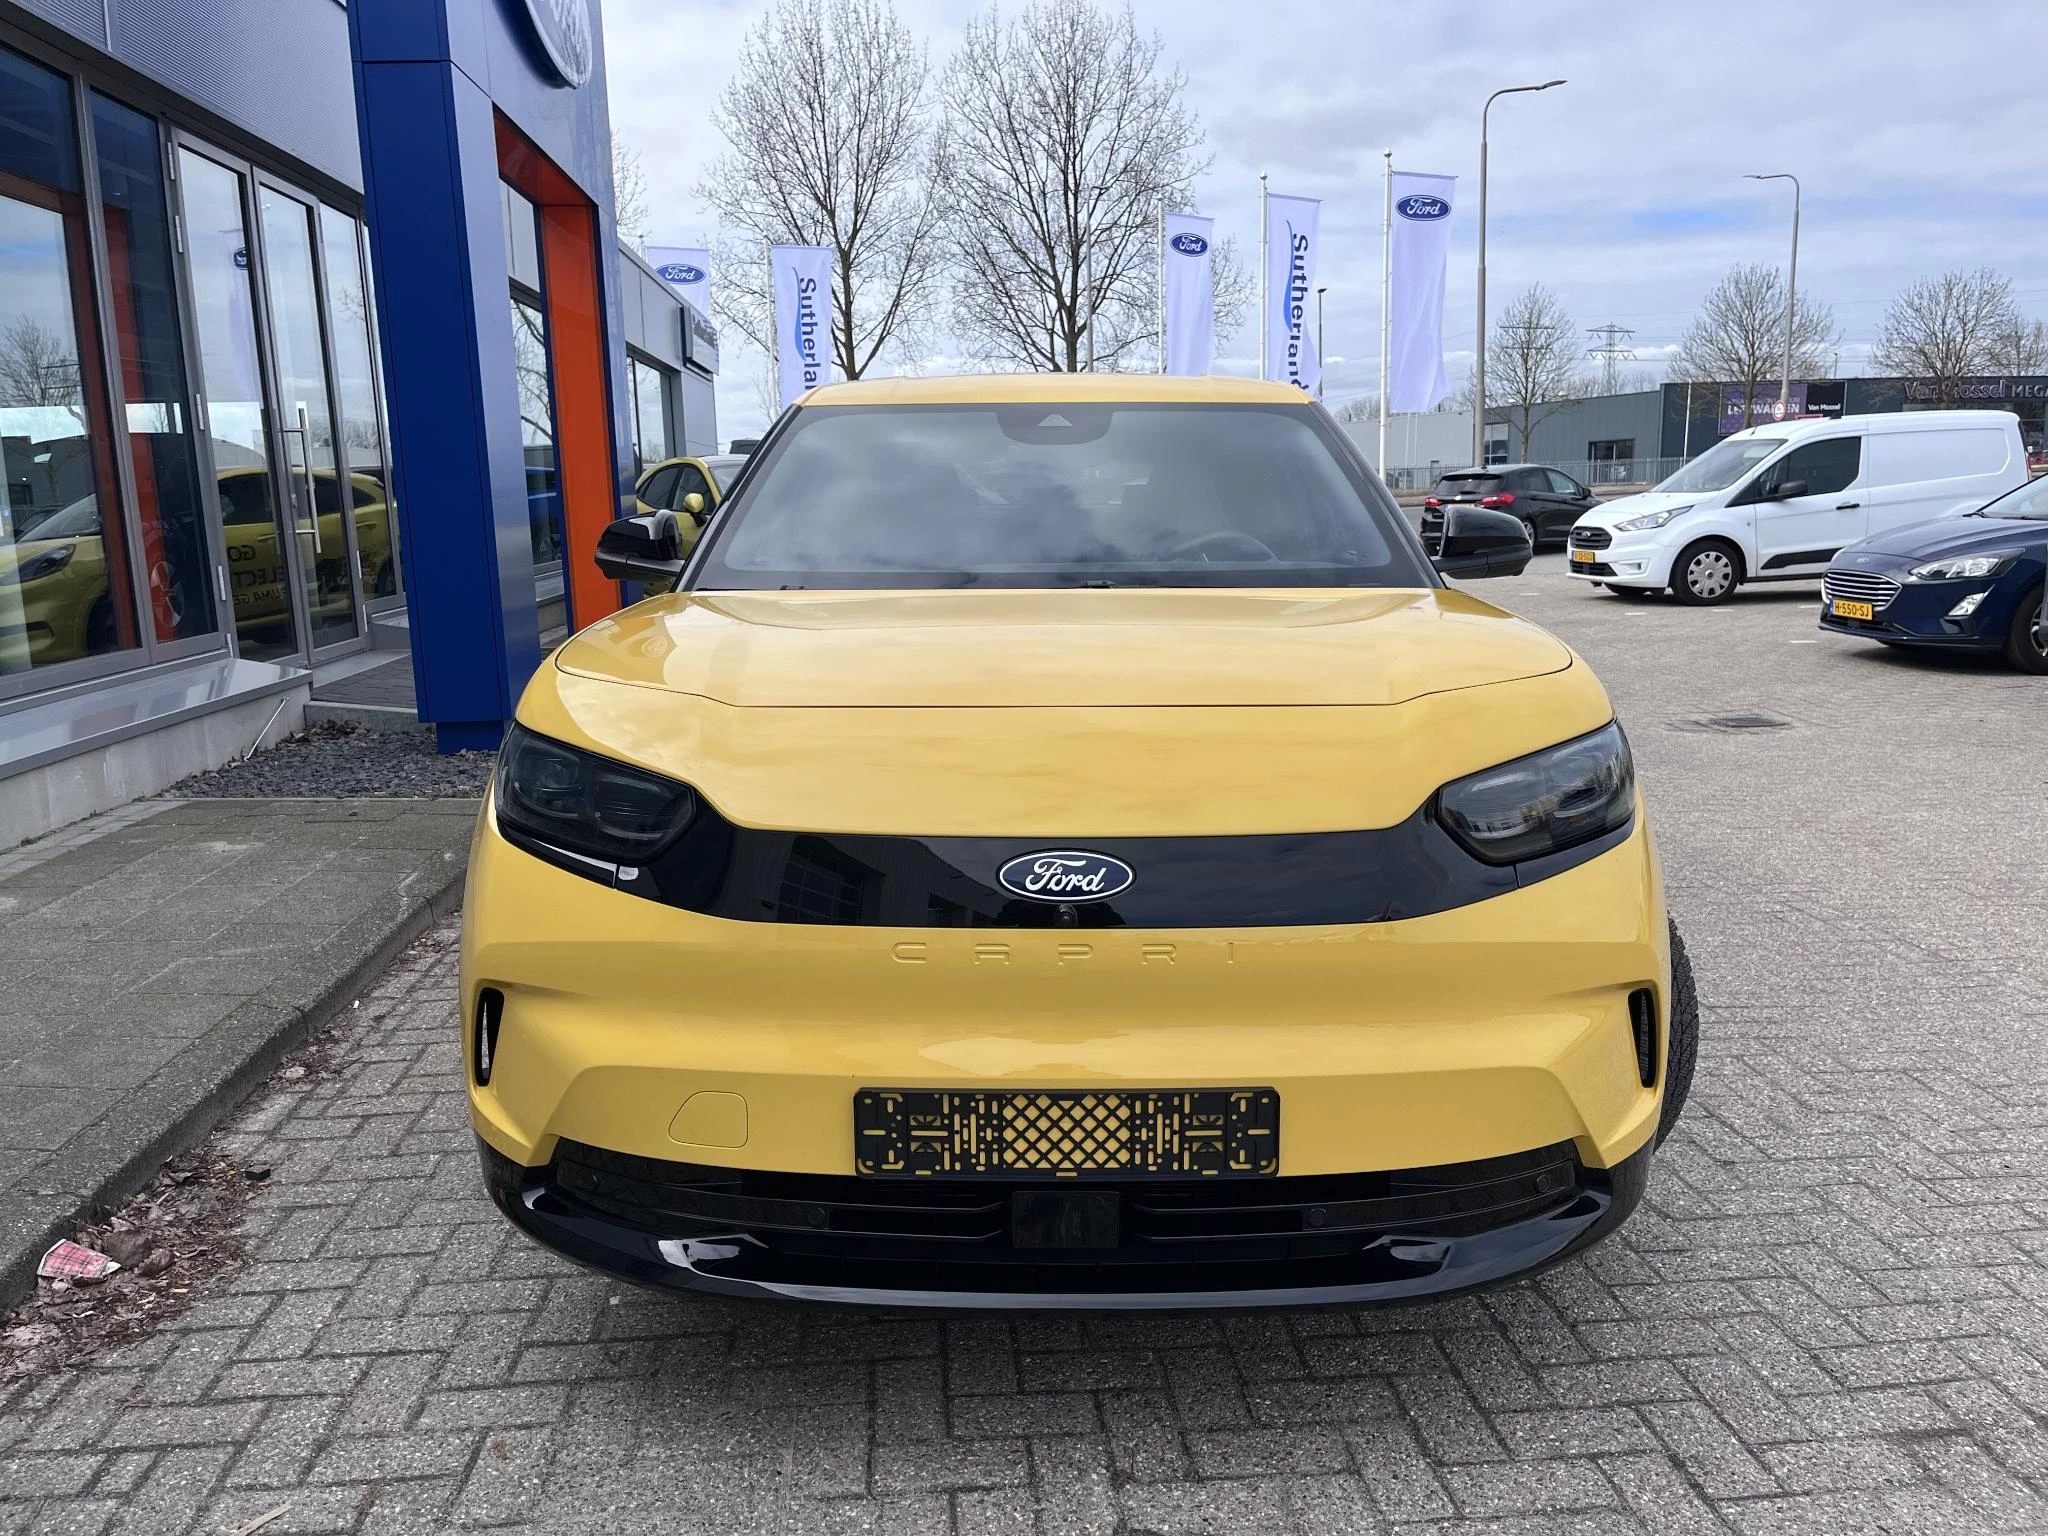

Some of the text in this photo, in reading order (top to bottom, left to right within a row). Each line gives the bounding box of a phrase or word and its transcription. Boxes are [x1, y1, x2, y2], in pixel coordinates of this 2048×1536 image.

[1406, 198, 1442, 216] Ford
[1178, 235, 1203, 252] Ford
[665, 266, 697, 280] Ford
[1836, 602, 1869, 617] H-550-SJ
[1024, 858, 1107, 892] Ford
[891, 942, 1236, 965] CAPRI
